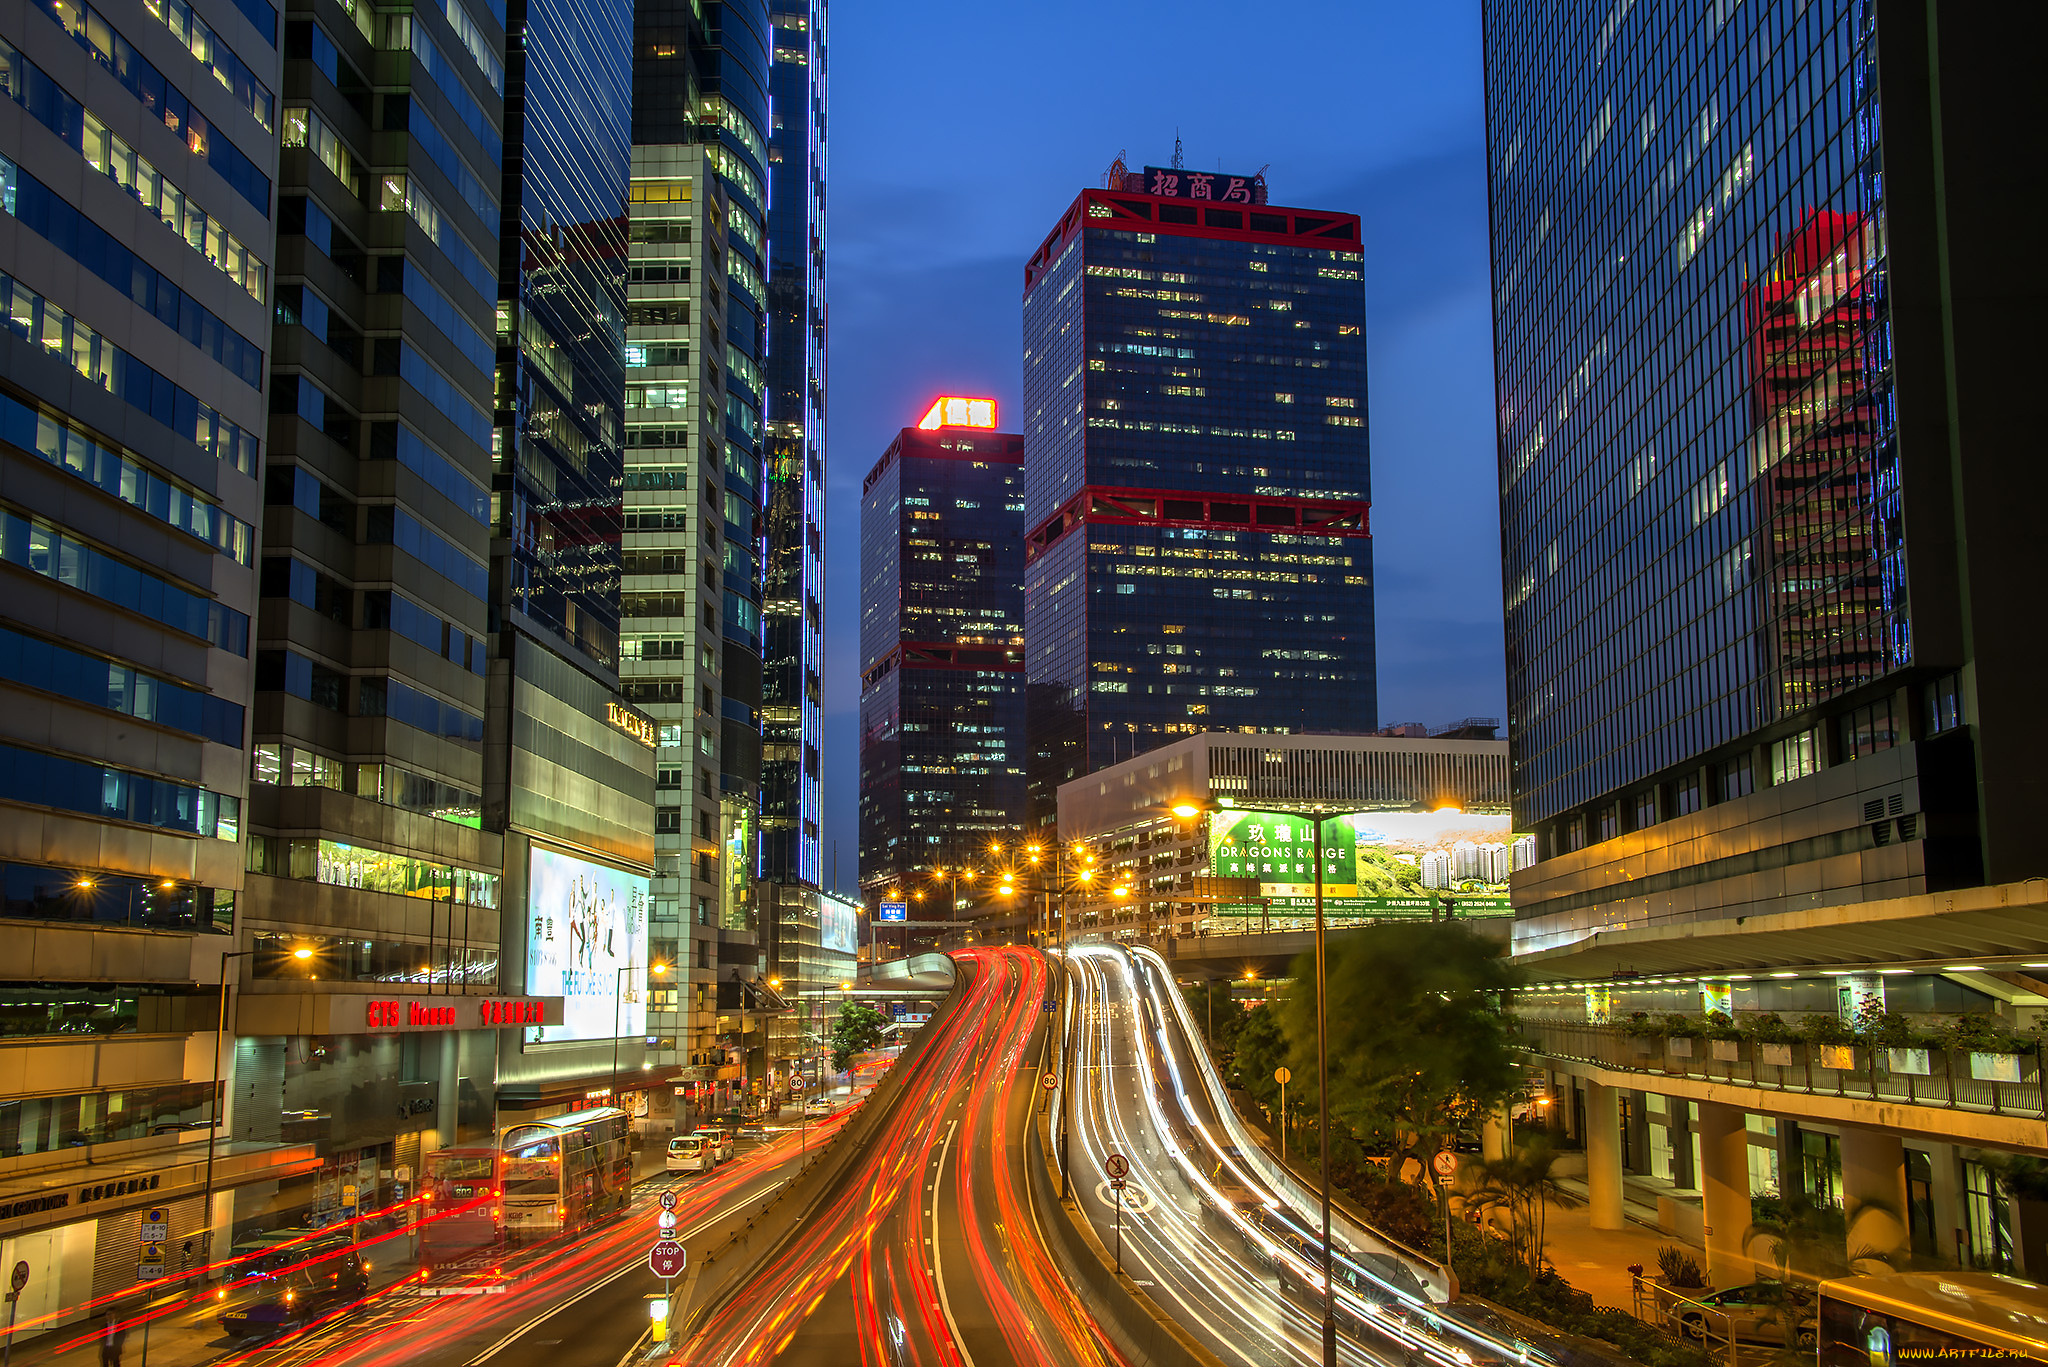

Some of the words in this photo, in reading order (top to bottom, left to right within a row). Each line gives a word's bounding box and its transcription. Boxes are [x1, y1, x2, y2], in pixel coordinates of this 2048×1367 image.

[1150, 170, 1251, 204] 招商局
[1247, 823, 1315, 843] 玖瓏山
[1220, 846, 1292, 859] DRAGONS
[561, 970, 573, 996] THE
[368, 1000, 400, 1028] CTS
[409, 1001, 456, 1026] House
[791, 1078, 803, 1087] 80
[1043, 1076, 1055, 1085] 80
[13, 1196, 43, 1217] GROUP
[44, 1193, 69, 1211] TOWER
[655, 1247, 680, 1256] STOP
[662, 1259, 673, 1271] 停
